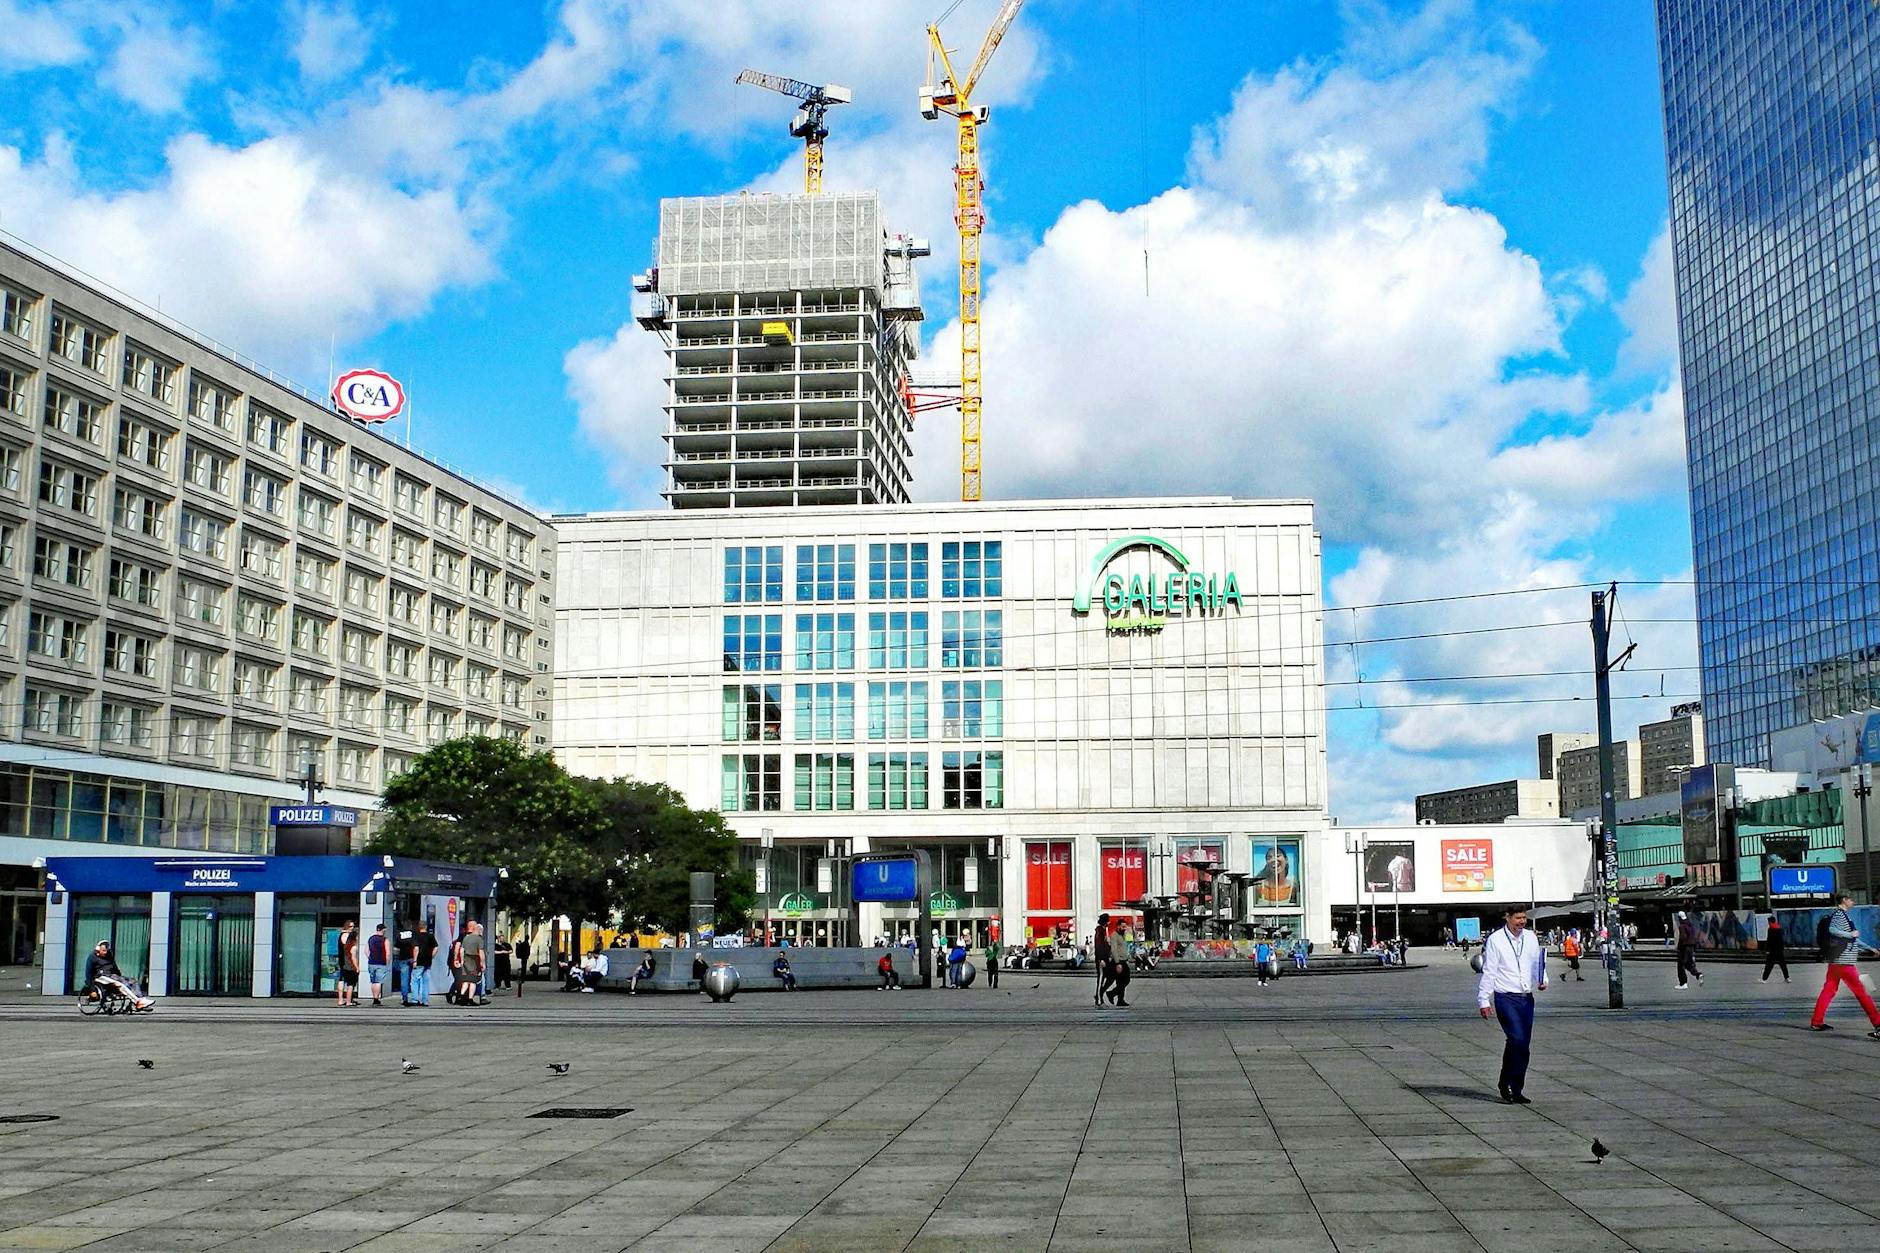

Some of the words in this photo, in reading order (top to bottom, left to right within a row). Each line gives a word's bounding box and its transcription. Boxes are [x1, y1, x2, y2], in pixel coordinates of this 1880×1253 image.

[348, 383, 391, 408] C&A
[1104, 571, 1244, 612] GALERIA
[279, 809, 323, 822] POLIZEI
[334, 810, 355, 824] POLIZEI
[1032, 852, 1070, 865] SALE
[1446, 847, 1488, 862] SALE
[1107, 857, 1143, 869] SALE
[193, 869, 231, 880] POLIZEI
[879, 864, 889, 883] U
[1797, 870, 1808, 883] U
